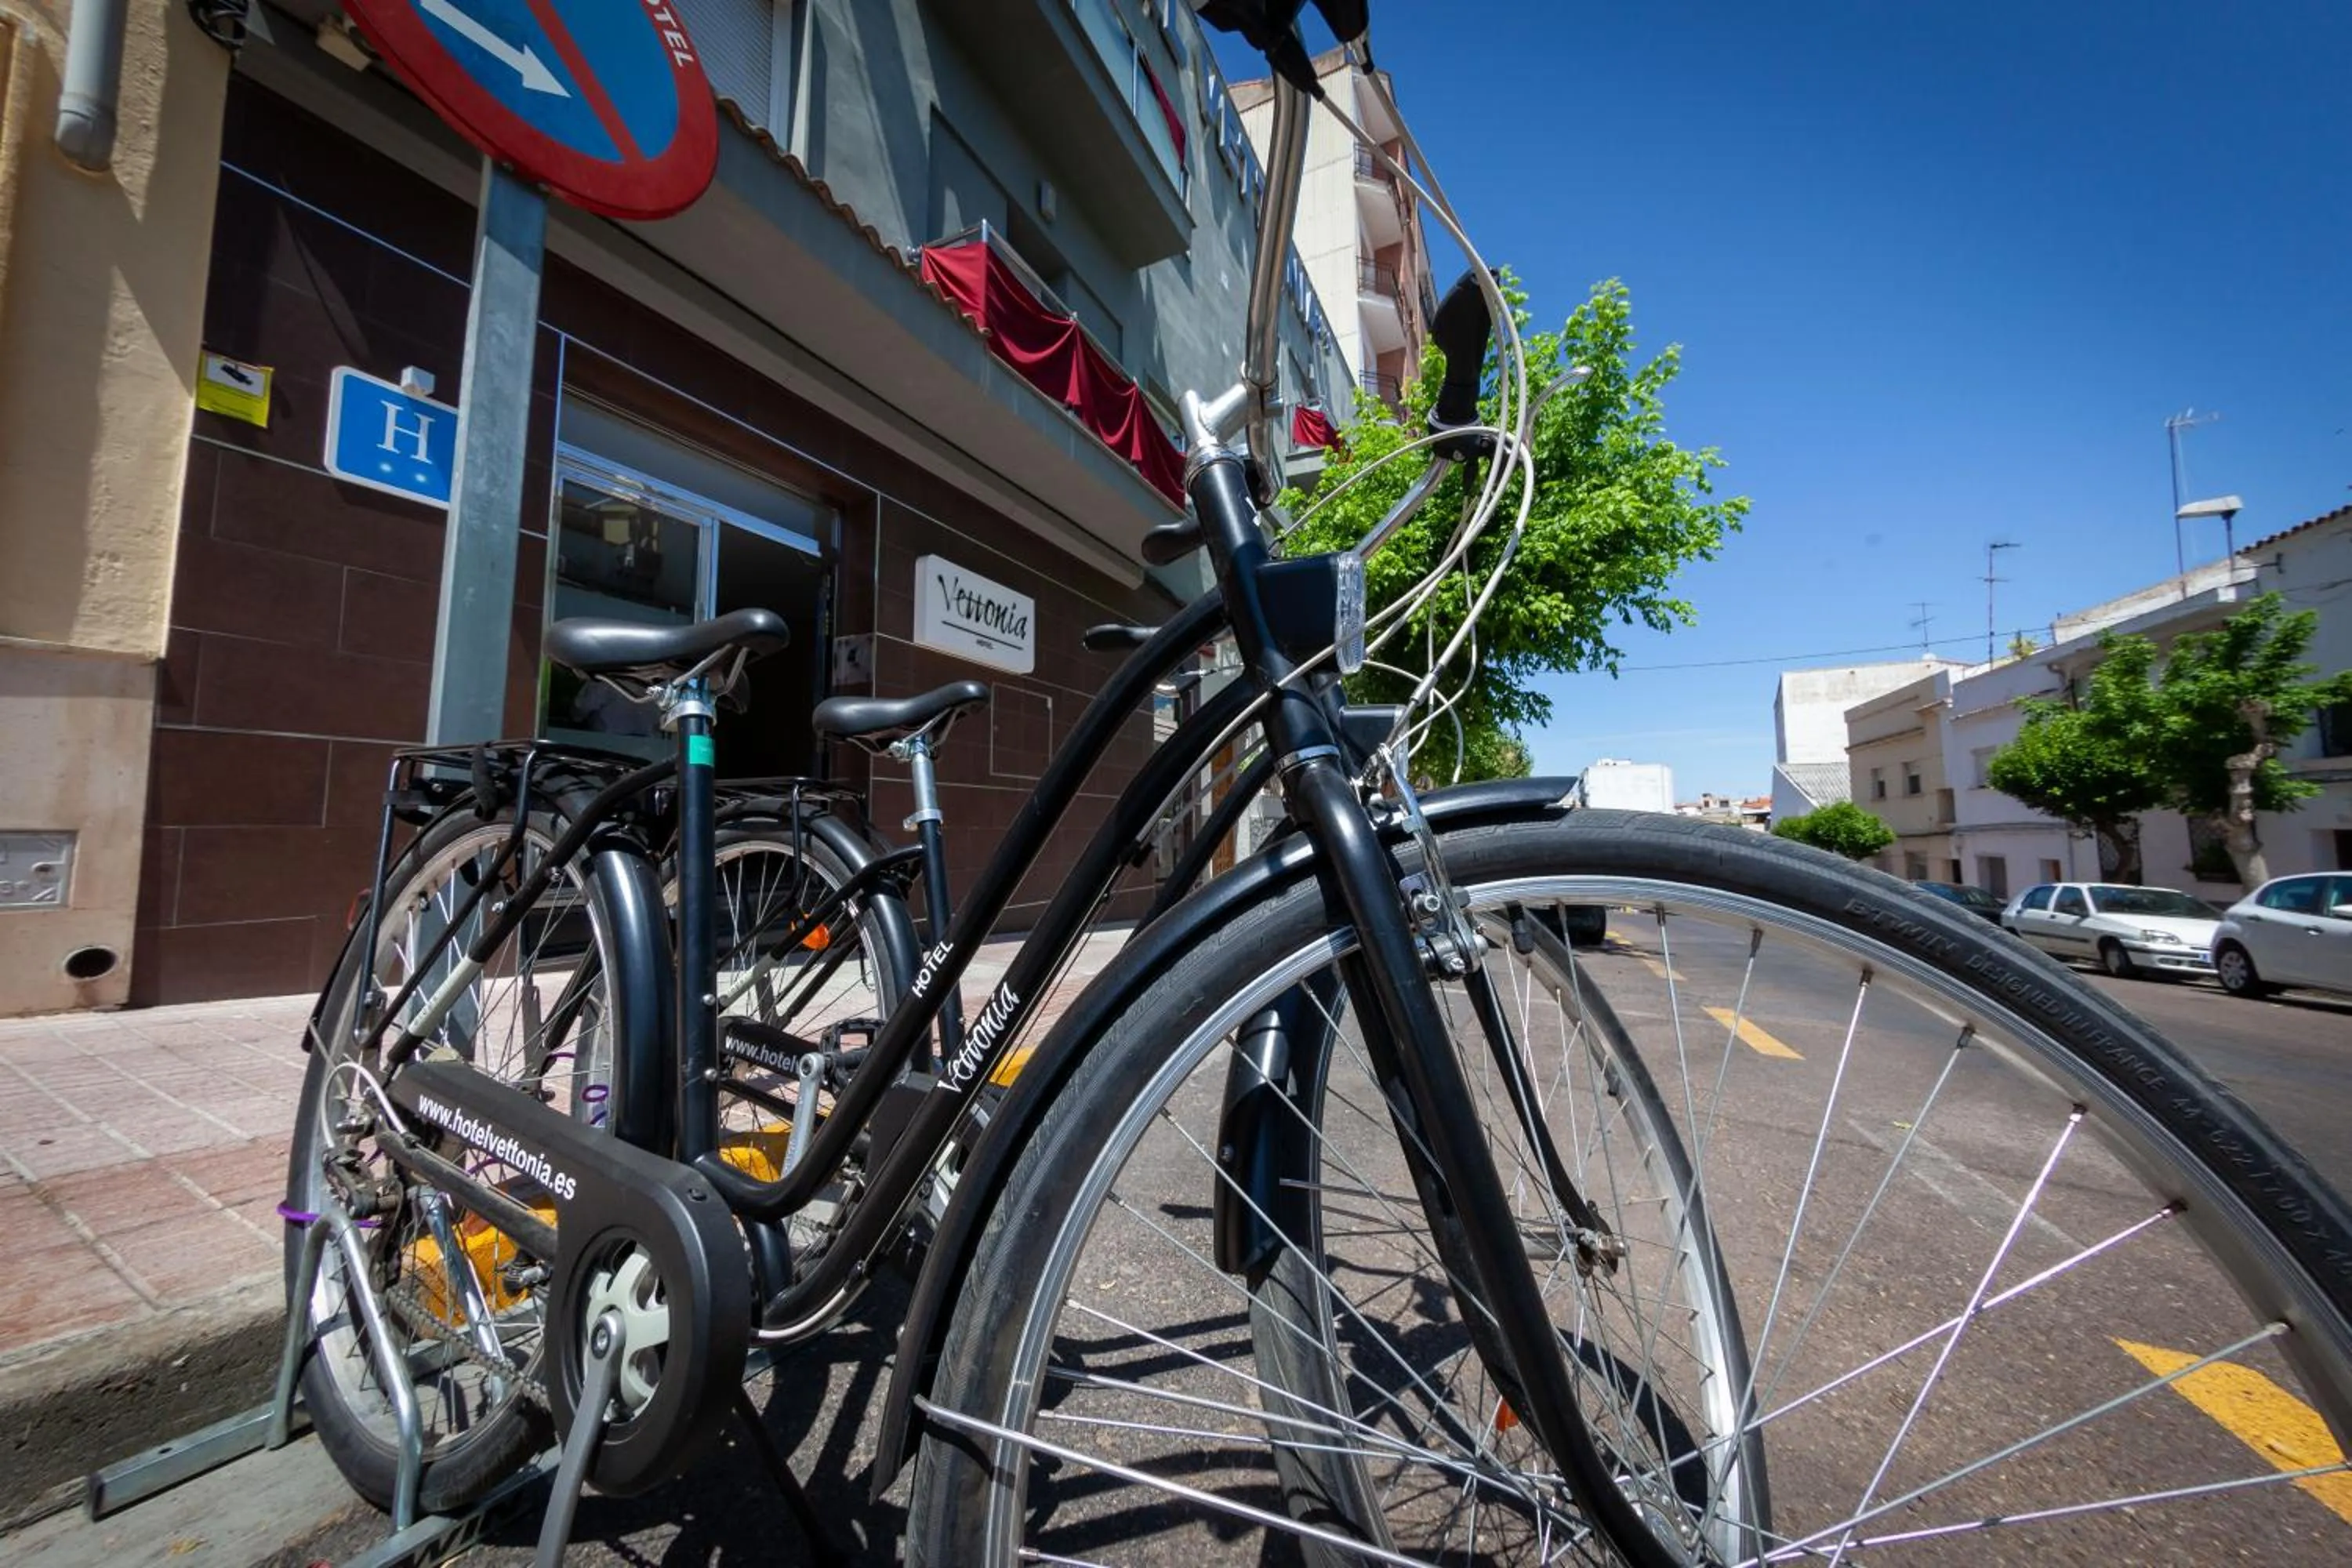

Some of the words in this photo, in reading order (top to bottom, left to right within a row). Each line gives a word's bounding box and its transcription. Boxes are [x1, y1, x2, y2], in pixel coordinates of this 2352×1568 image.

[646, 0, 695, 68] TEL
[376, 399, 437, 465] H
[936, 573, 1028, 641] Vettonia
[911, 940, 954, 999] HOTEL
[937, 981, 1021, 1094] Vettonia
[2084, 1027, 2169, 1091] FRANCE
[418, 1094, 578, 1200] www.hotelvettonia.es
